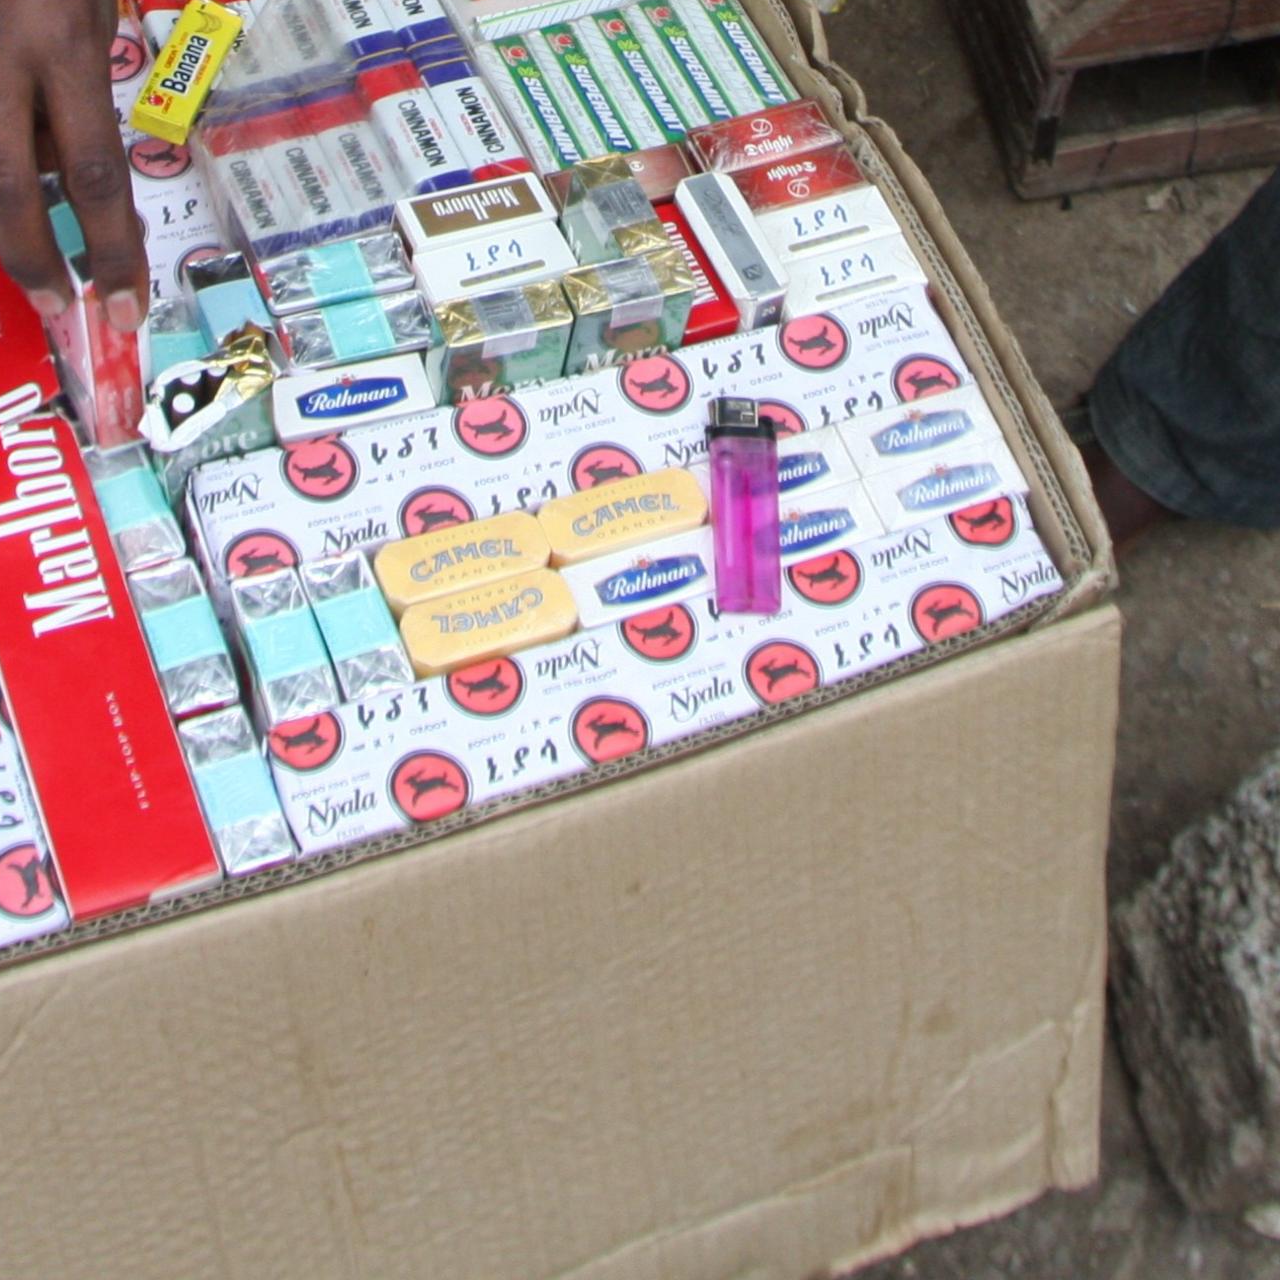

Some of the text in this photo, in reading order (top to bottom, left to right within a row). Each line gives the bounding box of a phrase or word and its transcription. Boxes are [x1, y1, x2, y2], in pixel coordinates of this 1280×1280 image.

[160, 35, 209, 94] Banana
[398, 99, 447, 168] CINNAMON
[455, 86, 505, 154] CINNAMON
[743, 135, 794, 158] Delight
[285, 147, 333, 215] CINNAMON
[767, 159, 817, 182] Delight
[431, 184, 520, 222] Marlboro
[859, 302, 914, 339] Nyala
[307, 383, 399, 415] Rothmans
[538, 387, 603, 426] Nyala
[201, 430, 258, 458] ore
[663, 438, 710, 468] Nyal
[881, 419, 967, 450] Rothmans
[199, 472, 263, 514] Nyala
[907, 472, 993, 505] Rothmans
[572, 493, 679, 537] CAMEL
[596, 515, 668, 540] ORANGE
[779, 515, 848, 547] othmans
[321, 518, 388, 557] Nyala
[872, 527, 933, 570] Nyala
[410, 538, 522, 583] CAMEL
[433, 560, 507, 586] ORANGE
[445, 582, 520, 610] ORANGE
[606, 560, 697, 601] Rothmans
[1000, 561, 1057, 605] Nyala
[431, 587, 543, 634] CAMEL
[535, 639, 602, 681] Nyala
[668, 676, 736, 724] Nyala
[304, 788, 377, 837] Nyala
